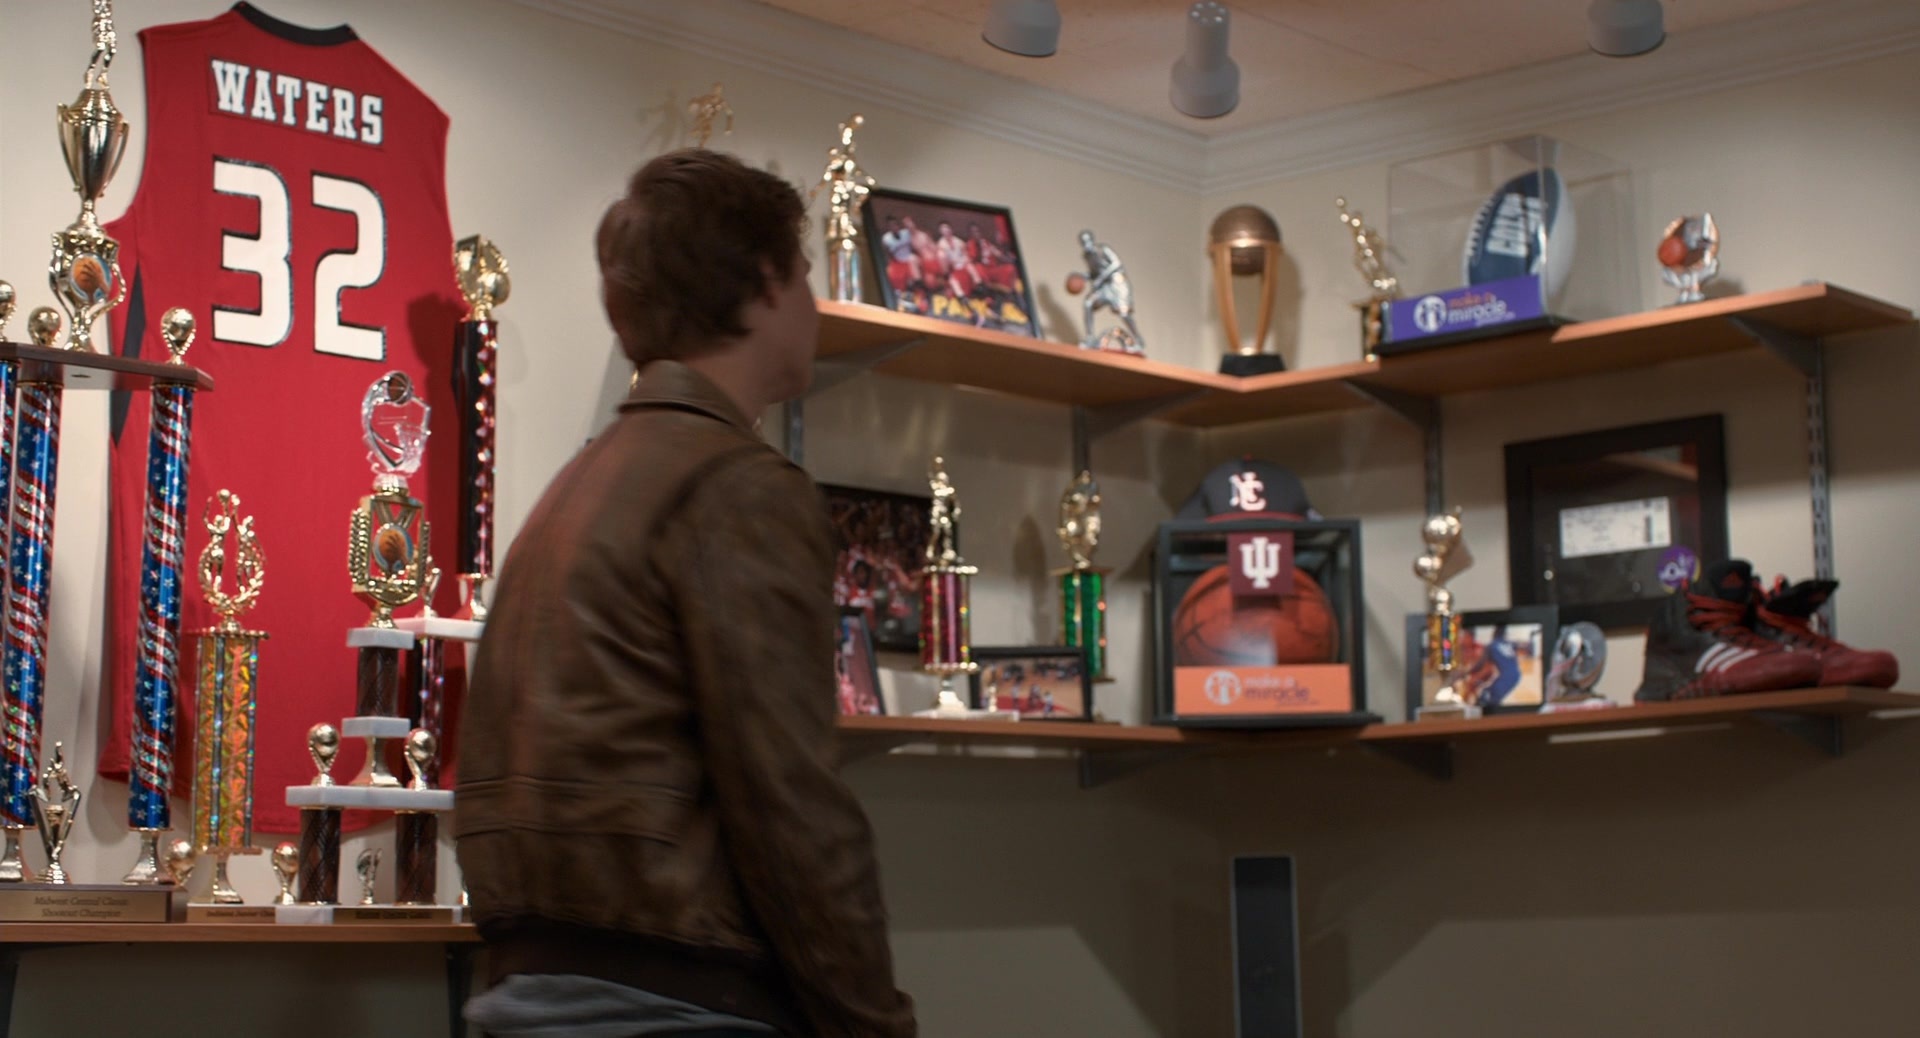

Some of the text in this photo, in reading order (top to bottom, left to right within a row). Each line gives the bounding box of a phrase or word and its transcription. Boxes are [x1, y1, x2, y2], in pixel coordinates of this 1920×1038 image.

[211, 59, 383, 144] WATERS
[213, 156, 387, 361] 32
[1447, 295, 1507, 324] miracle
[1246, 680, 1309, 700] miracle
[33, 896, 69, 905] Midwest
[41, 908, 121, 919] Shootout Champion
